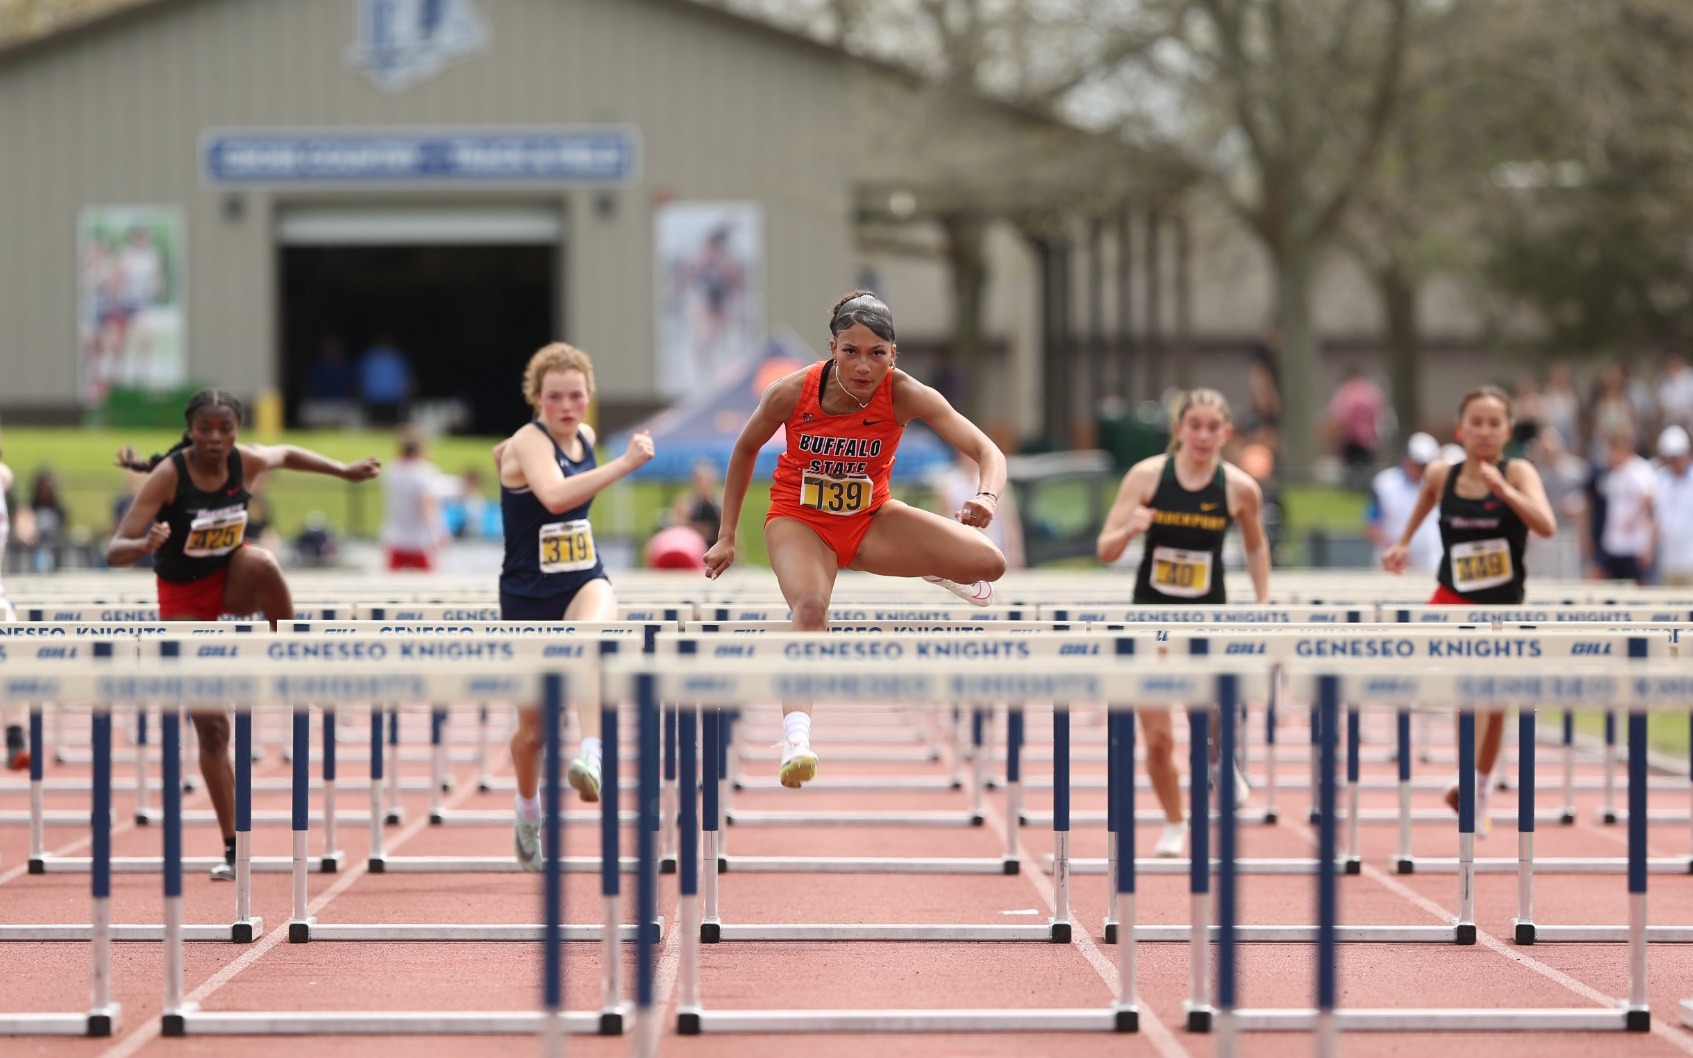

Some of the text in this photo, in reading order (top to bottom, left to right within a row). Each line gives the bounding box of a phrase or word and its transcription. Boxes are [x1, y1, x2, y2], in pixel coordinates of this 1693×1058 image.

[799, 433, 882, 457] BUFFALO
[809, 459, 868, 474] STATE
[812, 479, 863, 512] 139
[1152, 511, 1227, 531] ROCKPORT
[547, 532, 588, 563] 319
[101, 611, 157, 620] GENES
[443, 611, 498, 620] GENES
[875, 611, 950, 620] KNIGHTS
[1125, 611, 1289, 622] GENESEO KNIGHTS
[1467, 611, 1632, 621] GENESEO KNIGHTS
[268, 641, 513, 660] GENESEO KNIGHTS
[784, 641, 1030, 660] GENESEO KNIGHTS
[1225, 643, 1267, 655] GILL
[1295, 640, 1542, 657] GENESEO KNIGHTS
[1571, 641, 1613, 655] GILL
